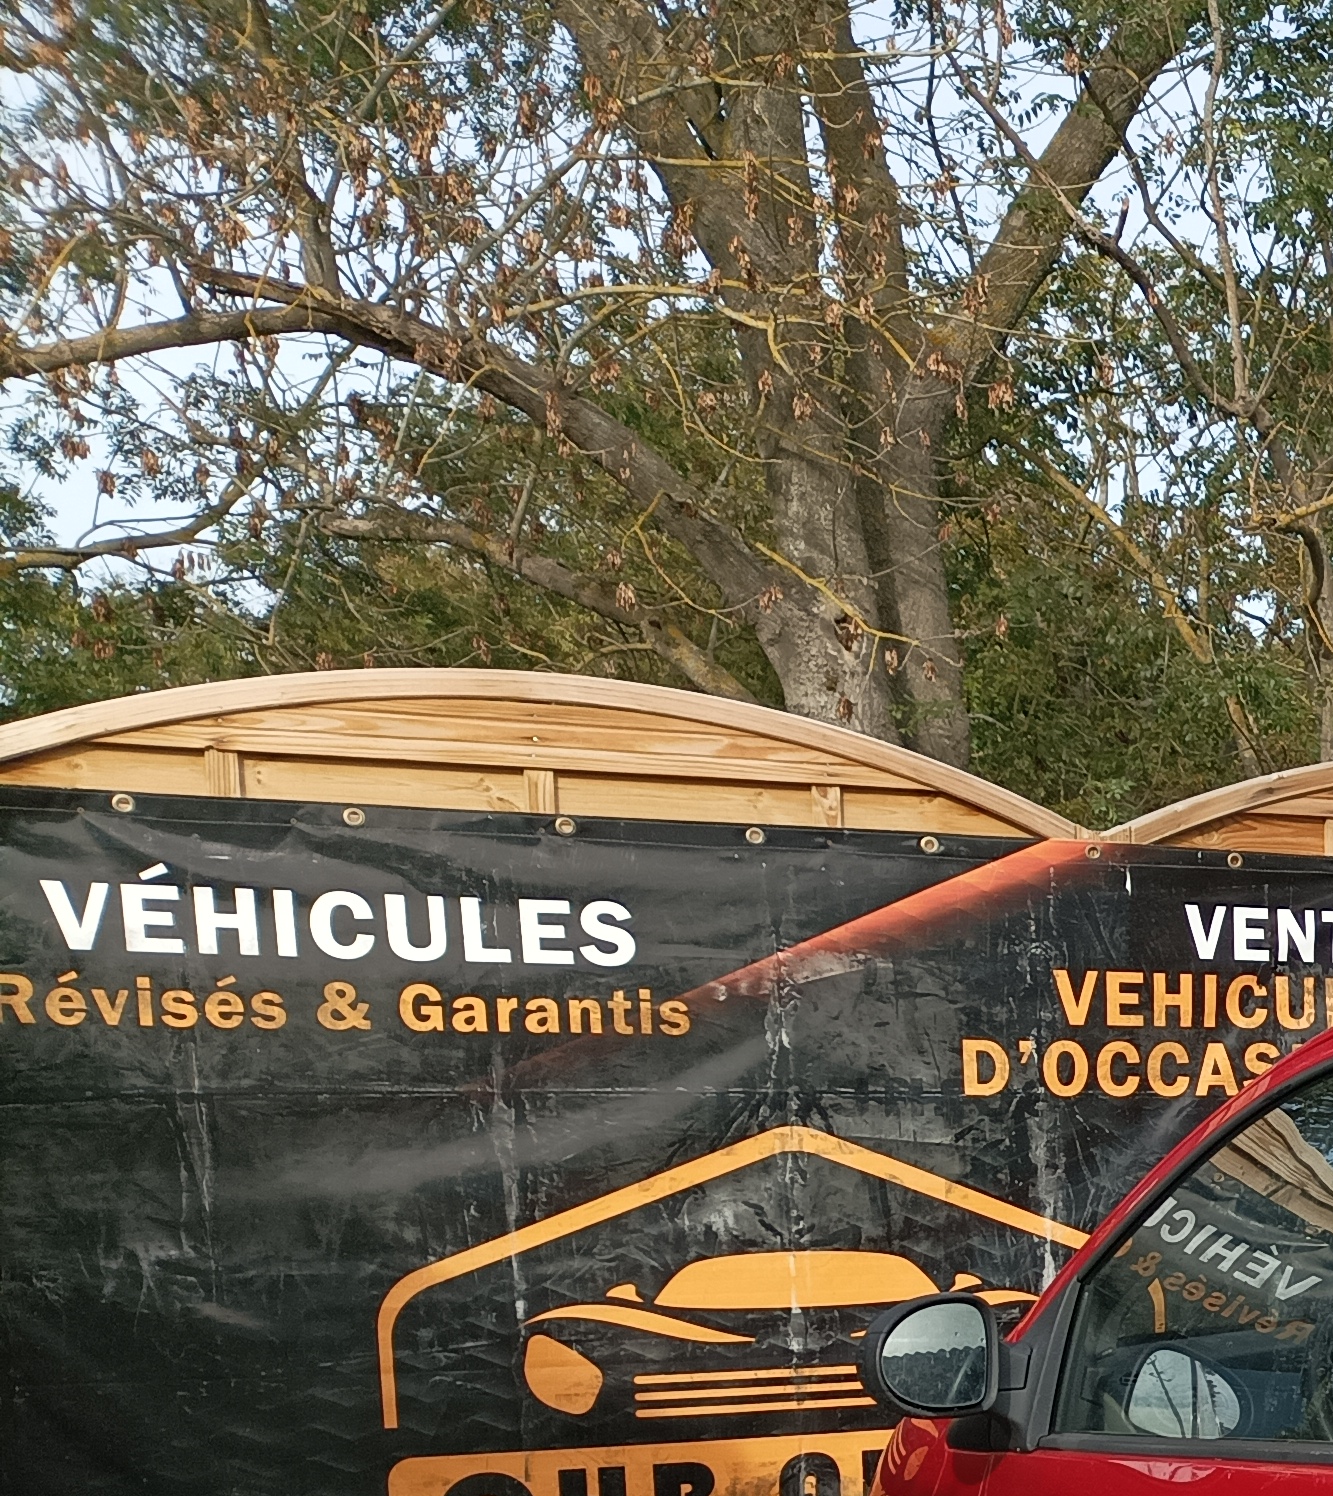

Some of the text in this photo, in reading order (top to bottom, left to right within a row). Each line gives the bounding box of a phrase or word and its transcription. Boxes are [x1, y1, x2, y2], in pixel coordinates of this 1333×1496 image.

[39, 862, 637, 967] VÉHICULES
[0, 969, 691, 1037] Révisés & Garantis
